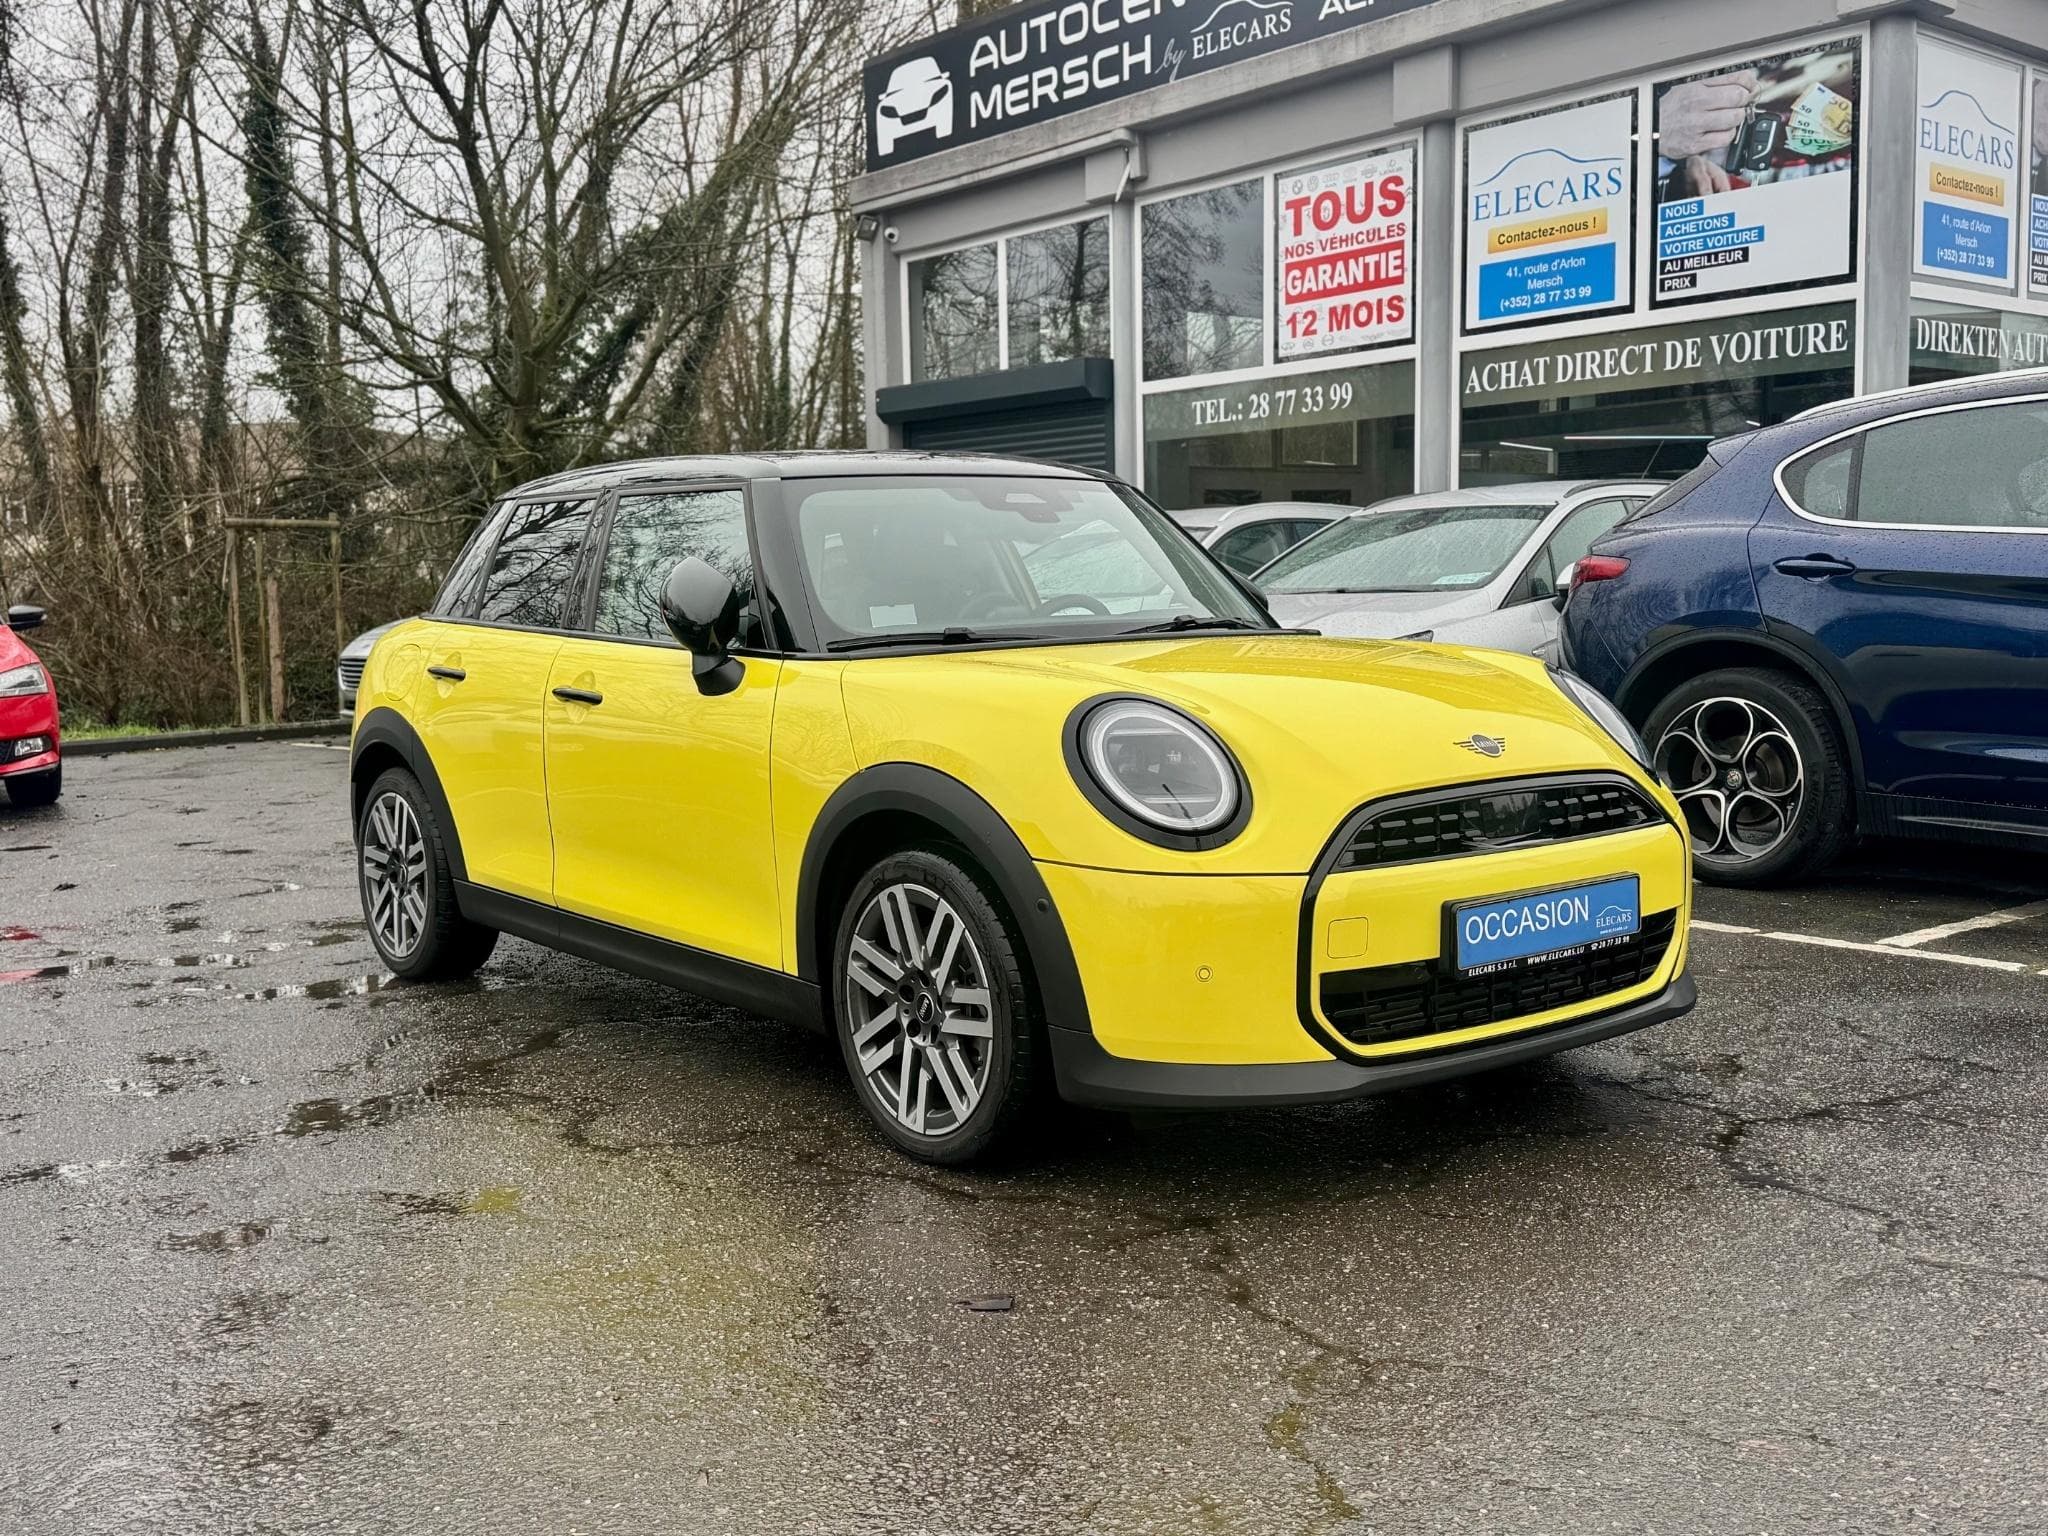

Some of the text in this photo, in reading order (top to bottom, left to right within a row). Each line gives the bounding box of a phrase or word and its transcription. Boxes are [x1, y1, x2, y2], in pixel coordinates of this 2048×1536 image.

[970, 34, 1151, 128] MERSCH
[1155, 38, 1187, 83] by
[1192, 8, 1293, 60] ELECARS
[1919, 117, 2014, 169] ELECARS
[1473, 166, 1622, 222] ELECARS
[1936, 172, 1993, 197] Contactez-nous
[1285, 175, 1406, 237] TOUS
[1665, 203, 1698, 218] NOUS
[1497, 216, 1597, 245] Contactez-nous !
[1665, 216, 1729, 237] ACHETONS
[1953, 217, 1969, 230] route
[1285, 222, 1406, 260] NOS VÉHICULES
[1664, 229, 1759, 255] VOTRE VOITURE
[1955, 233, 1978, 248] Mersch
[1506, 257, 1586, 278] 41, route d'Arlon
[1664, 250, 1743, 273] AU MEILLEUR
[1937, 247, 1958, 264] (+352)
[1286, 249, 1403, 297] GARANTIE
[1527, 275, 1563, 290] Mersch
[1664, 277, 1691, 291] PRIX
[1500, 285, 1592, 312] (+352) 28 77 33 99
[1286, 294, 1405, 339] 12 MOIS
[1916, 318, 2048, 363] DIREKTEN AUT
[1464, 320, 1848, 394] ACHAT DIRECT DE VOITURE
[1192, 382, 1353, 425] TEL.: 28 77 33 99
[1465, 895, 1589, 944] OCCASION
[1595, 912, 1632, 928] ELECARS
[1468, 964, 1496, 977] ELECARS
